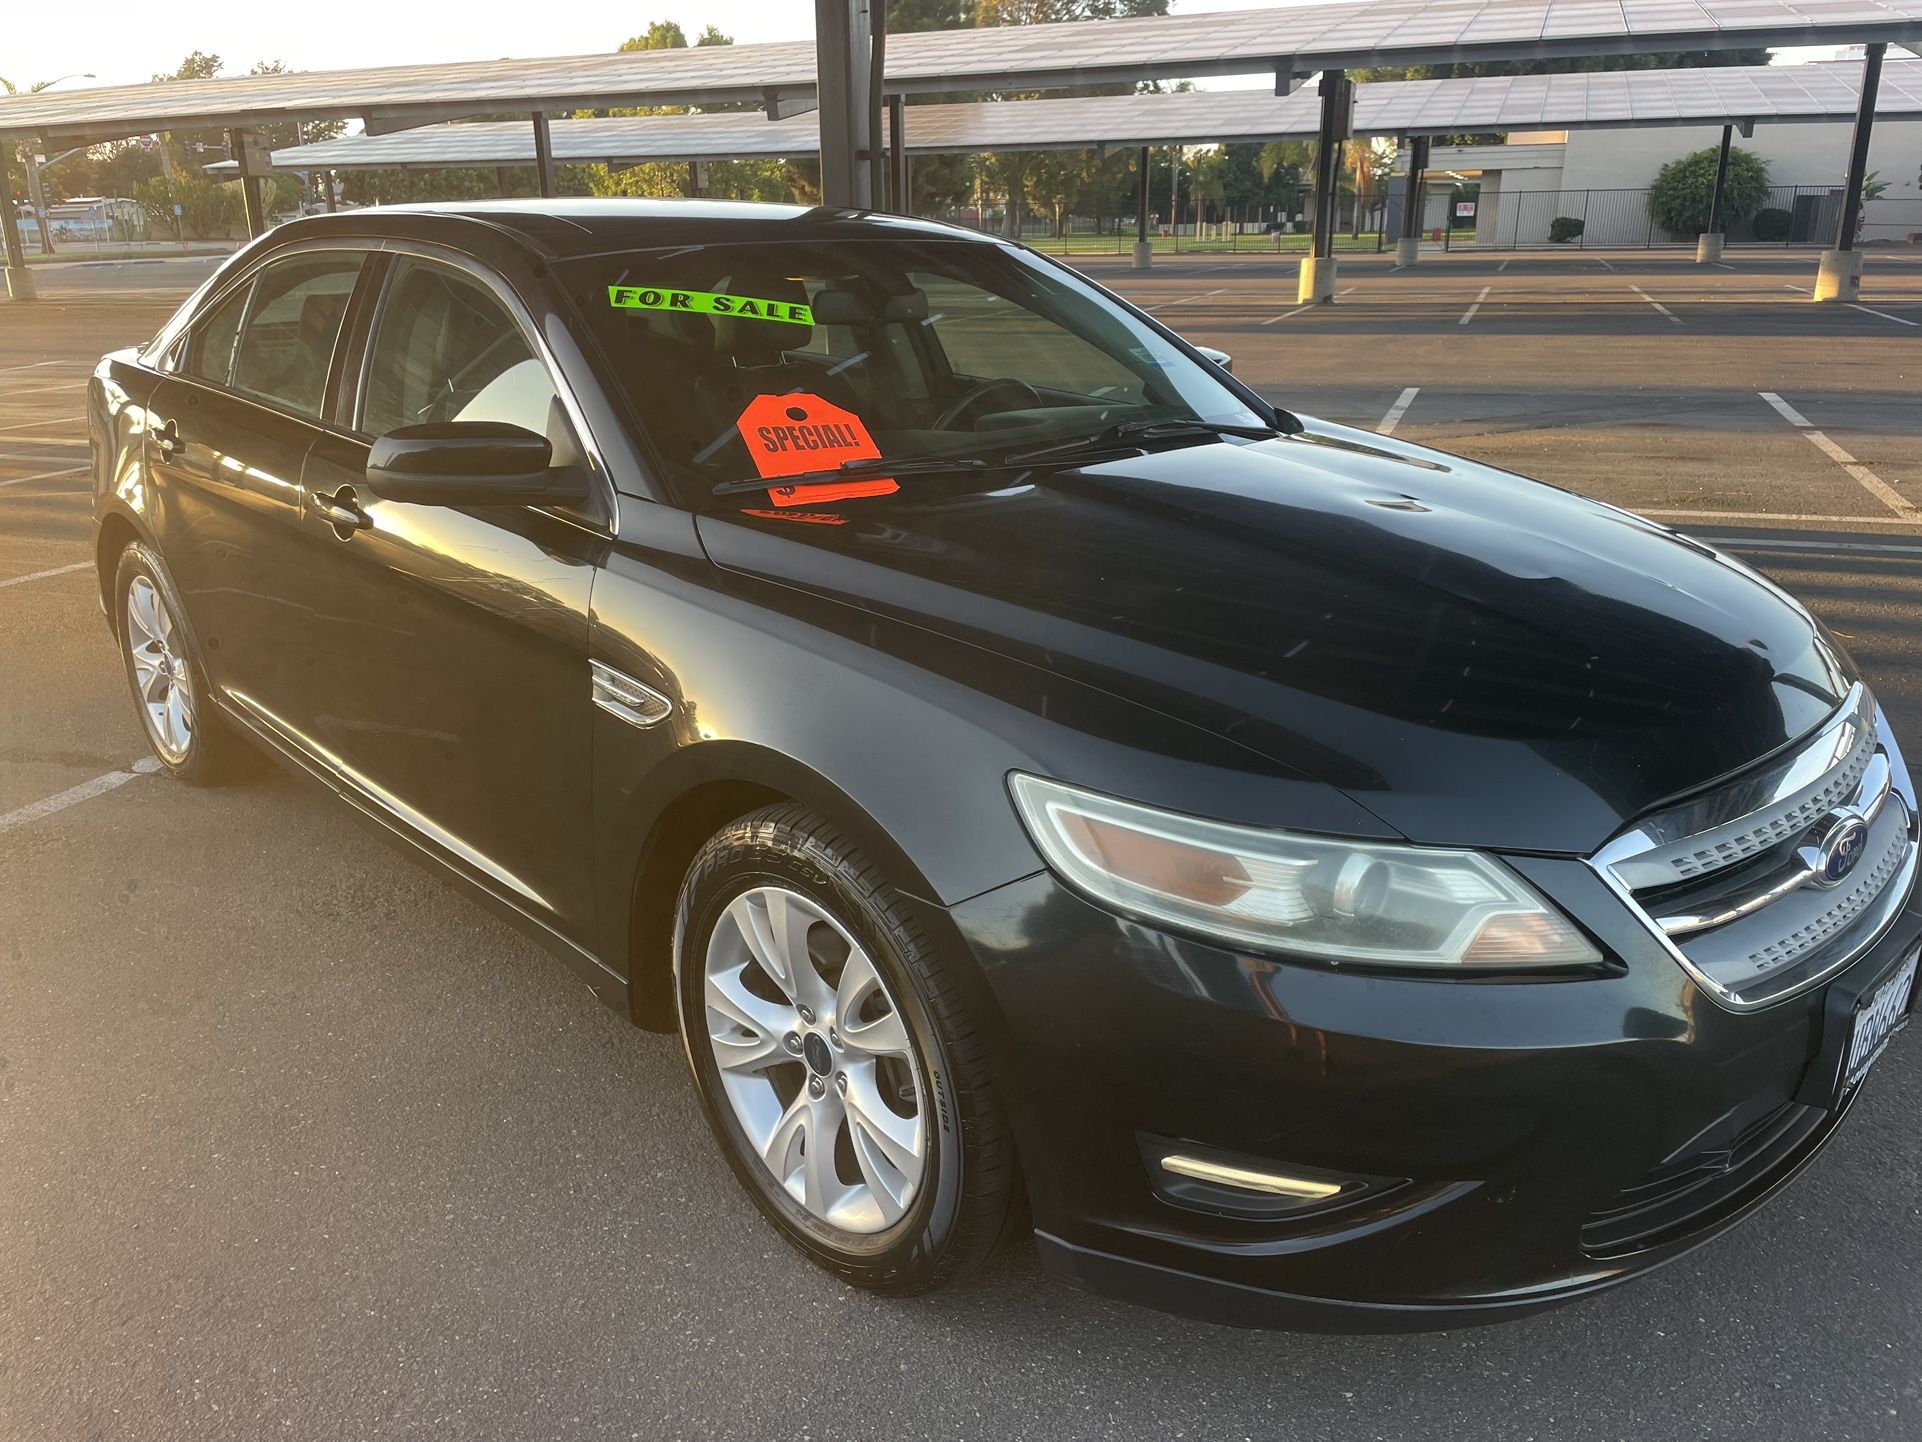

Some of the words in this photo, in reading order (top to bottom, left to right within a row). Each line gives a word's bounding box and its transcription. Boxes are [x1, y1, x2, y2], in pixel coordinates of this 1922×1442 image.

[614, 289, 693, 309] FOR
[713, 297, 809, 321] SALE
[758, 424, 861, 452] SPECIAL!
[933, 1070, 950, 1134] OUTSIDE
